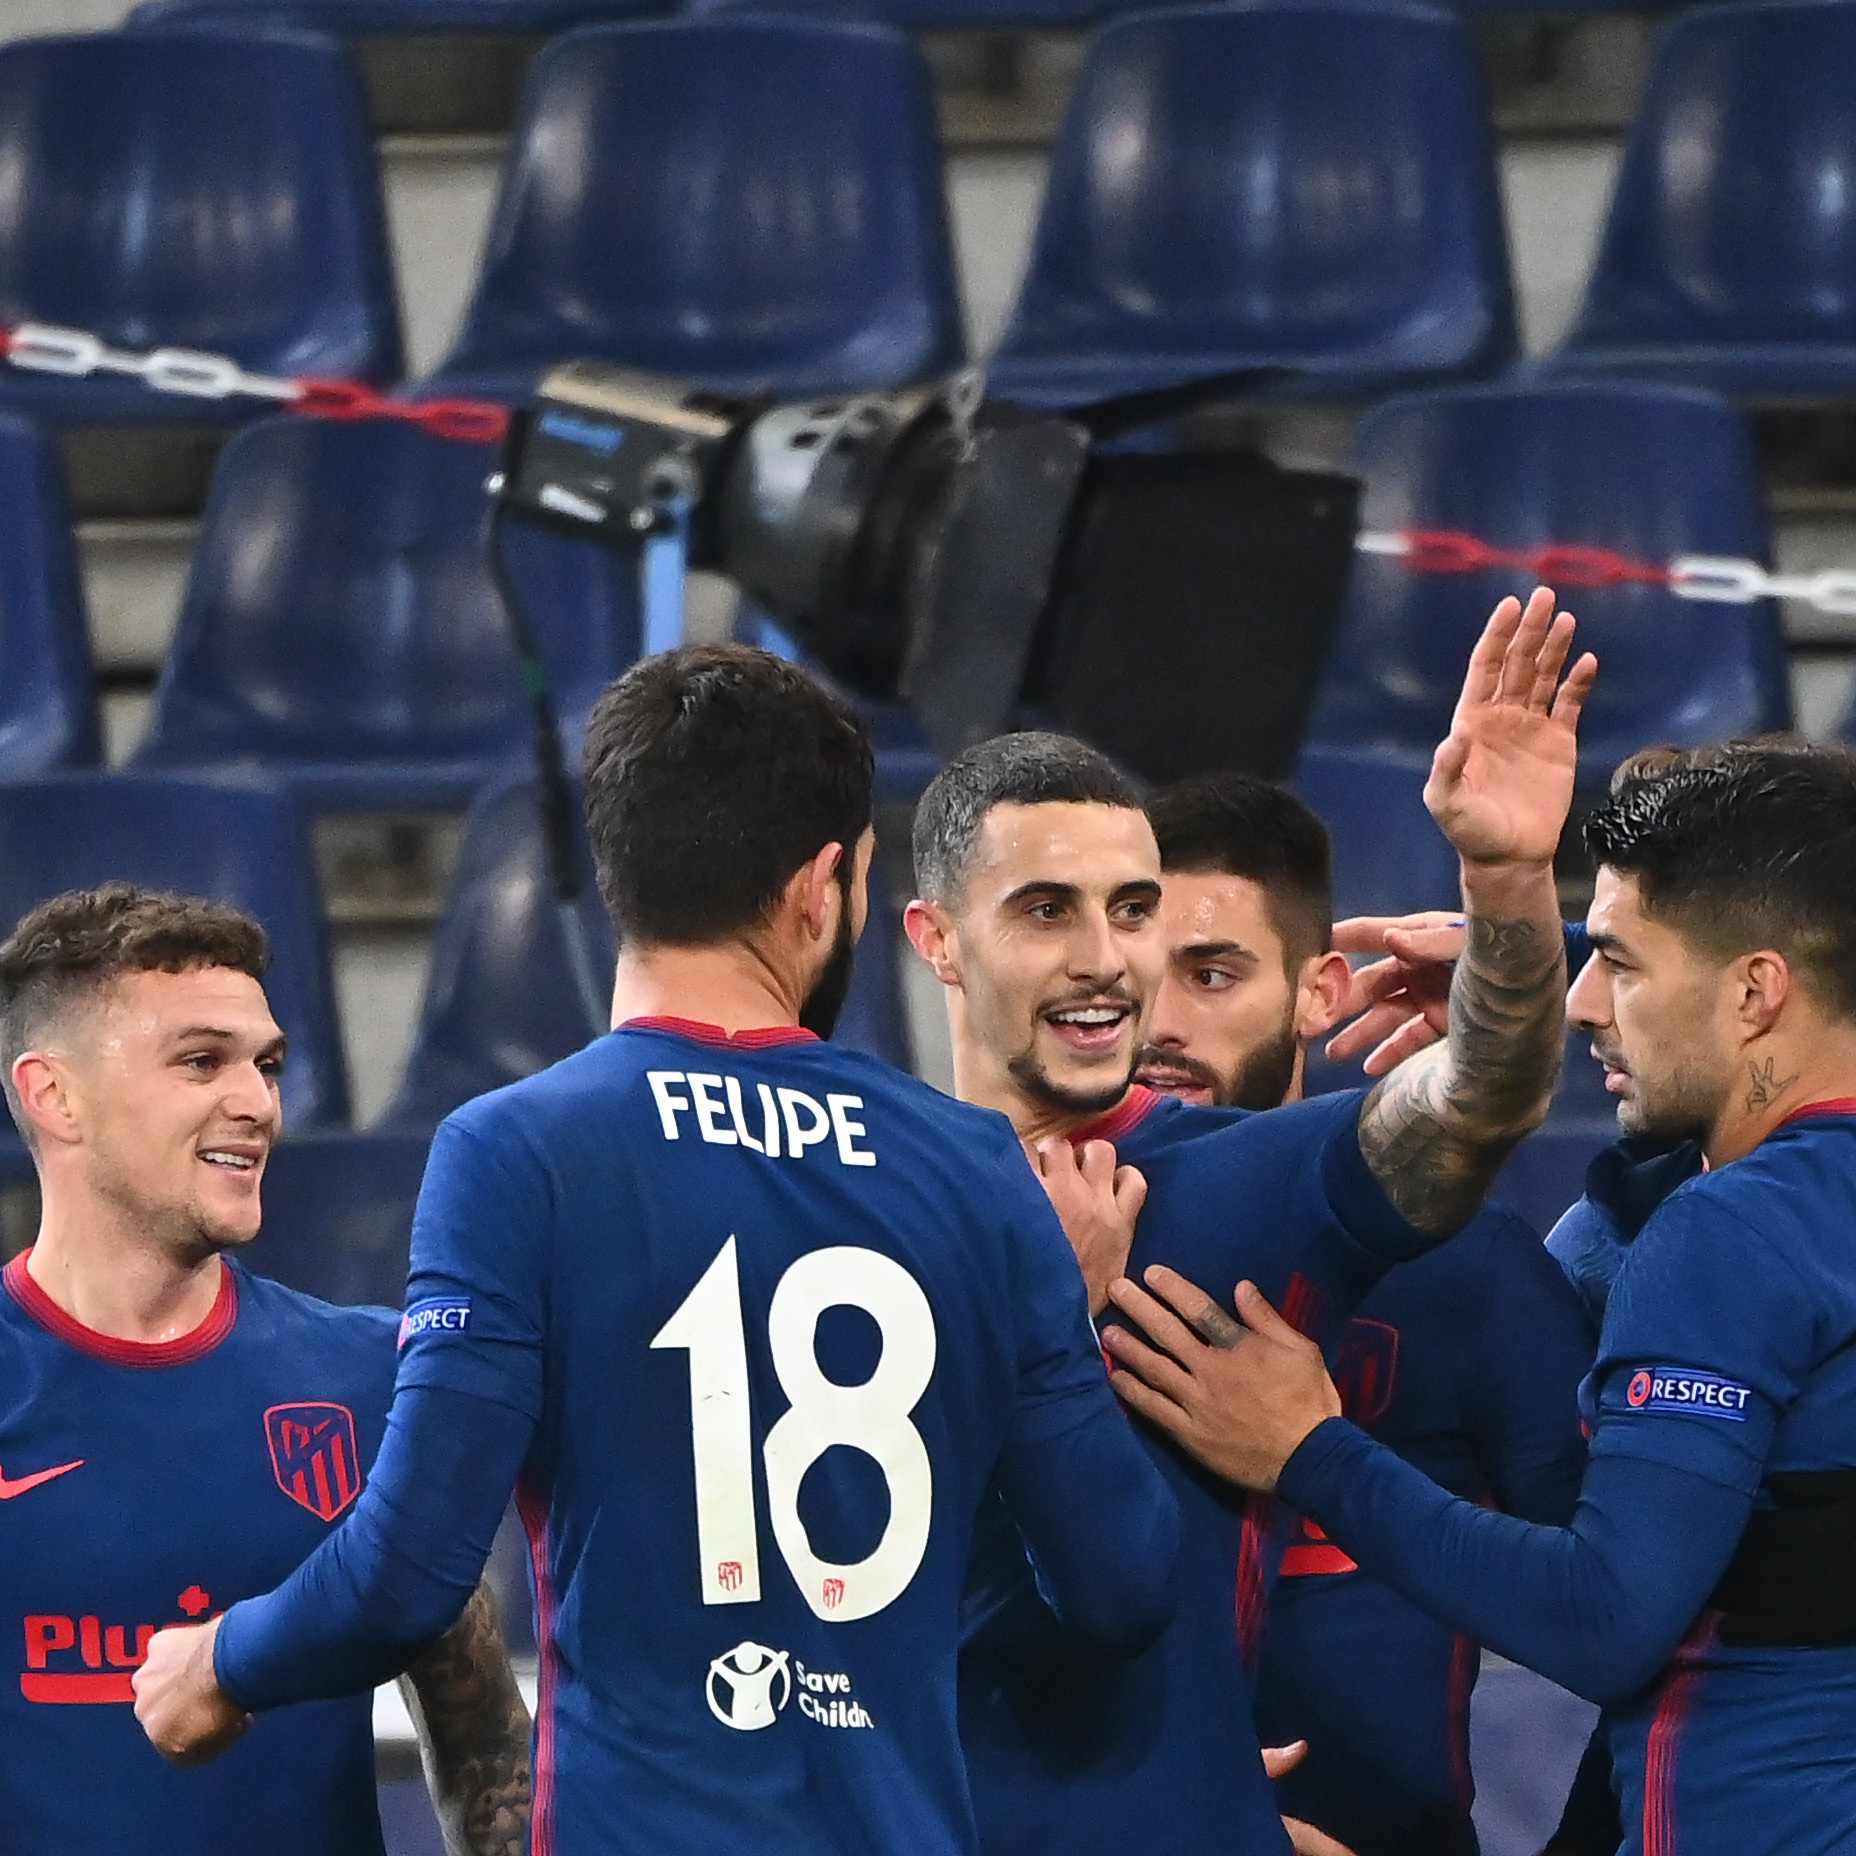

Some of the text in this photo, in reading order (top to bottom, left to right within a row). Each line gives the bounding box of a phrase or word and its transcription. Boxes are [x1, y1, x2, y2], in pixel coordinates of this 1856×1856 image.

[646, 1070, 877, 1167] FELIPE
[1651, 1379, 1751, 1409] RESPECT
[649, 1233, 937, 1623] 18
[795, 1660, 851, 1694] Save
